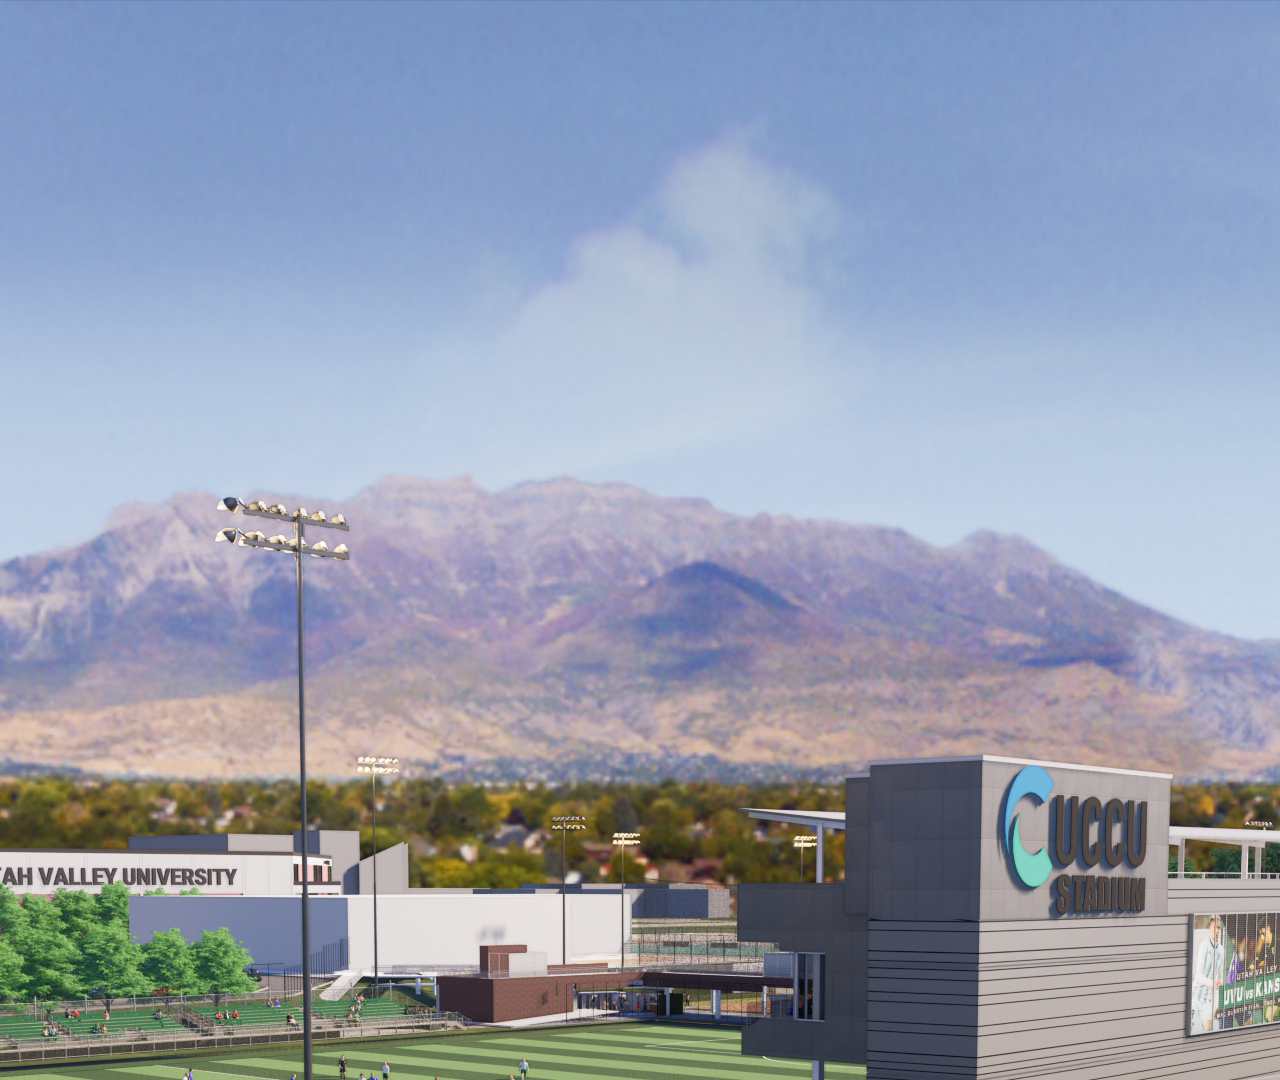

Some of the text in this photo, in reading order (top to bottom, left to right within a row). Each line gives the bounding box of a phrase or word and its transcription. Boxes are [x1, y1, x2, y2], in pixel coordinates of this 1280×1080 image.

[1055, 794, 1148, 868] UCCU
[38, 867, 117, 886] VALLEY
[122, 867, 238, 886] UNIVERSITY
[1055, 874, 1146, 914] STADIUM
[1255, 965, 1278, 977] VALEY
[1223, 986, 1244, 1005] UVU
